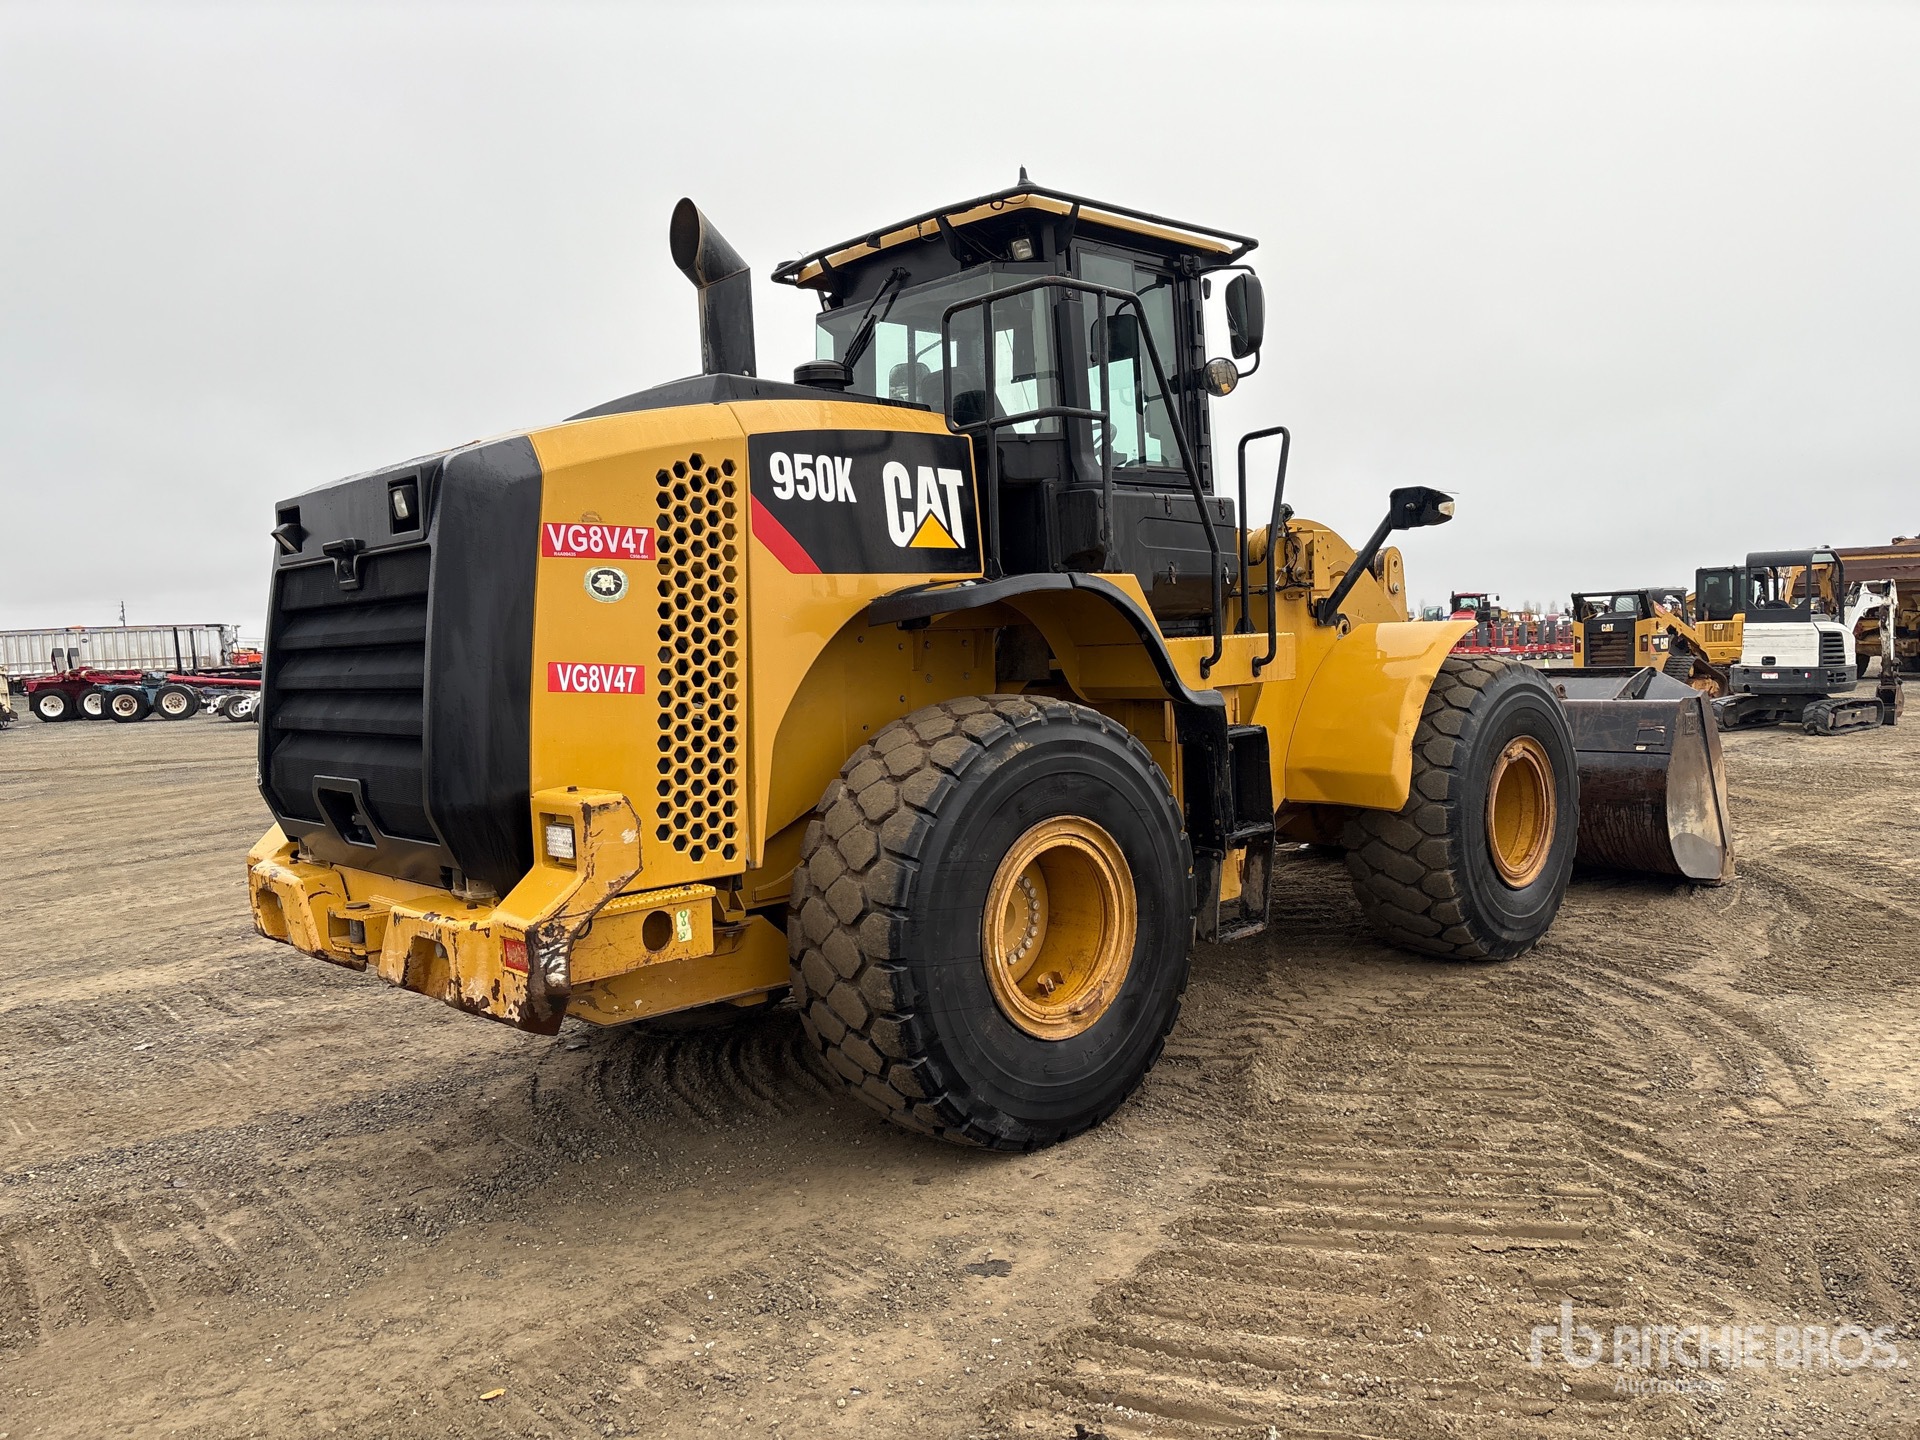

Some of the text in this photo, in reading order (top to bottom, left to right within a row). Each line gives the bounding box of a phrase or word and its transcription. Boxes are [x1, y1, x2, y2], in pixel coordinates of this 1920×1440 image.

[769, 451, 857, 503] 950K
[883, 461, 965, 548] CAT
[546, 524, 649, 554] VG8V47
[1601, 624, 1614, 632] CAT
[556, 663, 637, 693] VG8V47
